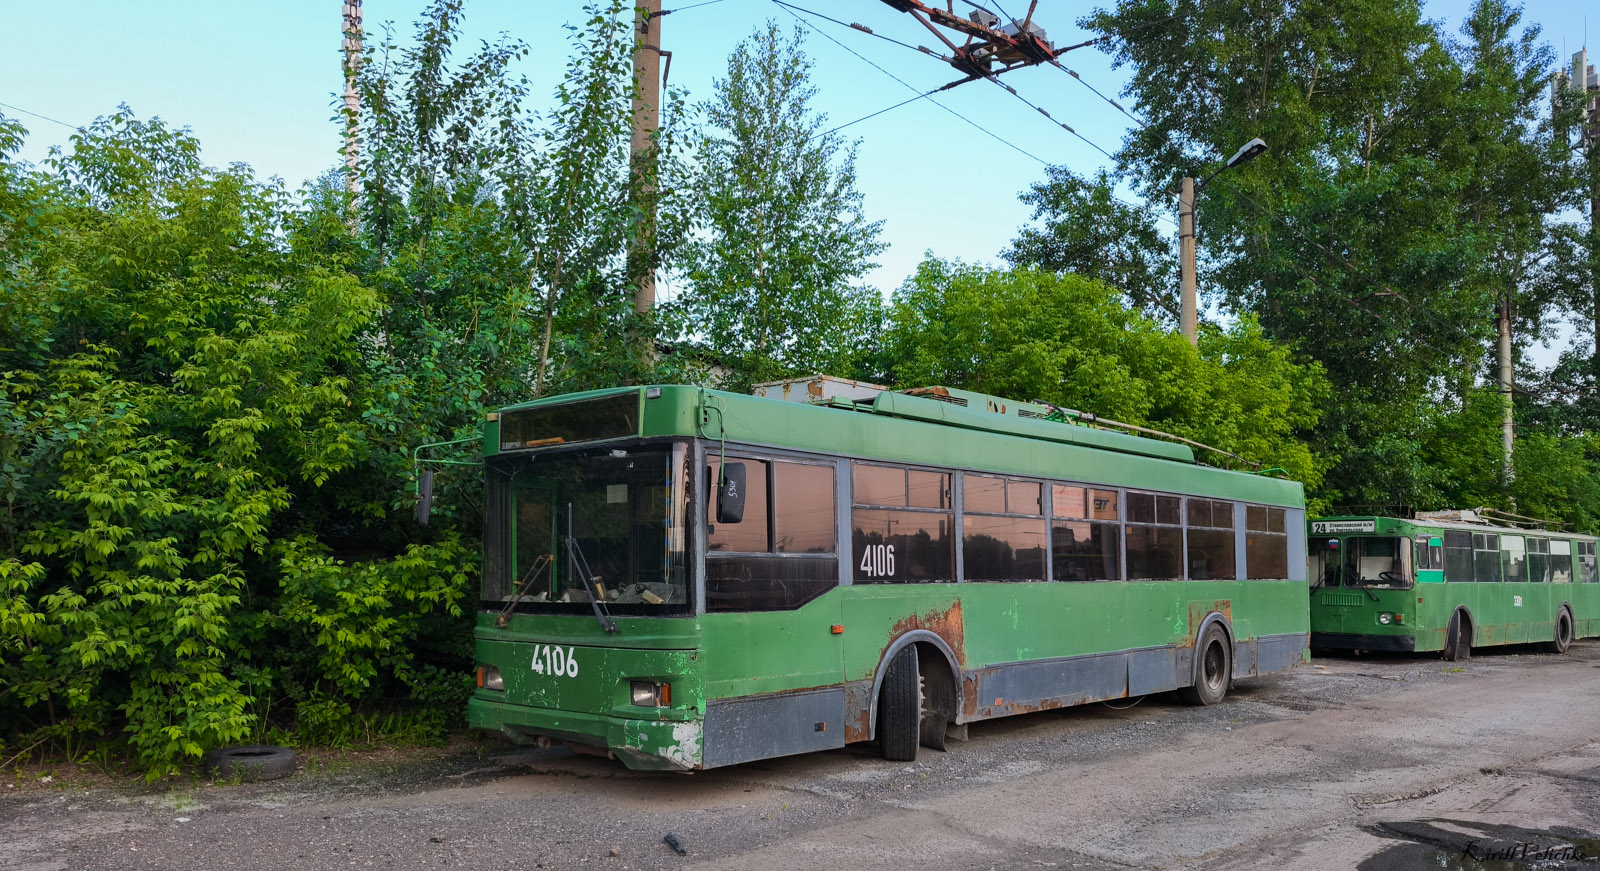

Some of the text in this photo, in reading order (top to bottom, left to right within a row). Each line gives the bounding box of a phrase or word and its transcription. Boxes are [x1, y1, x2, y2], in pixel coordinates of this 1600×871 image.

[1315, 523, 1326, 533] 24
[860, 544, 895, 577] 4106
[531, 644, 579, 678] 4106
